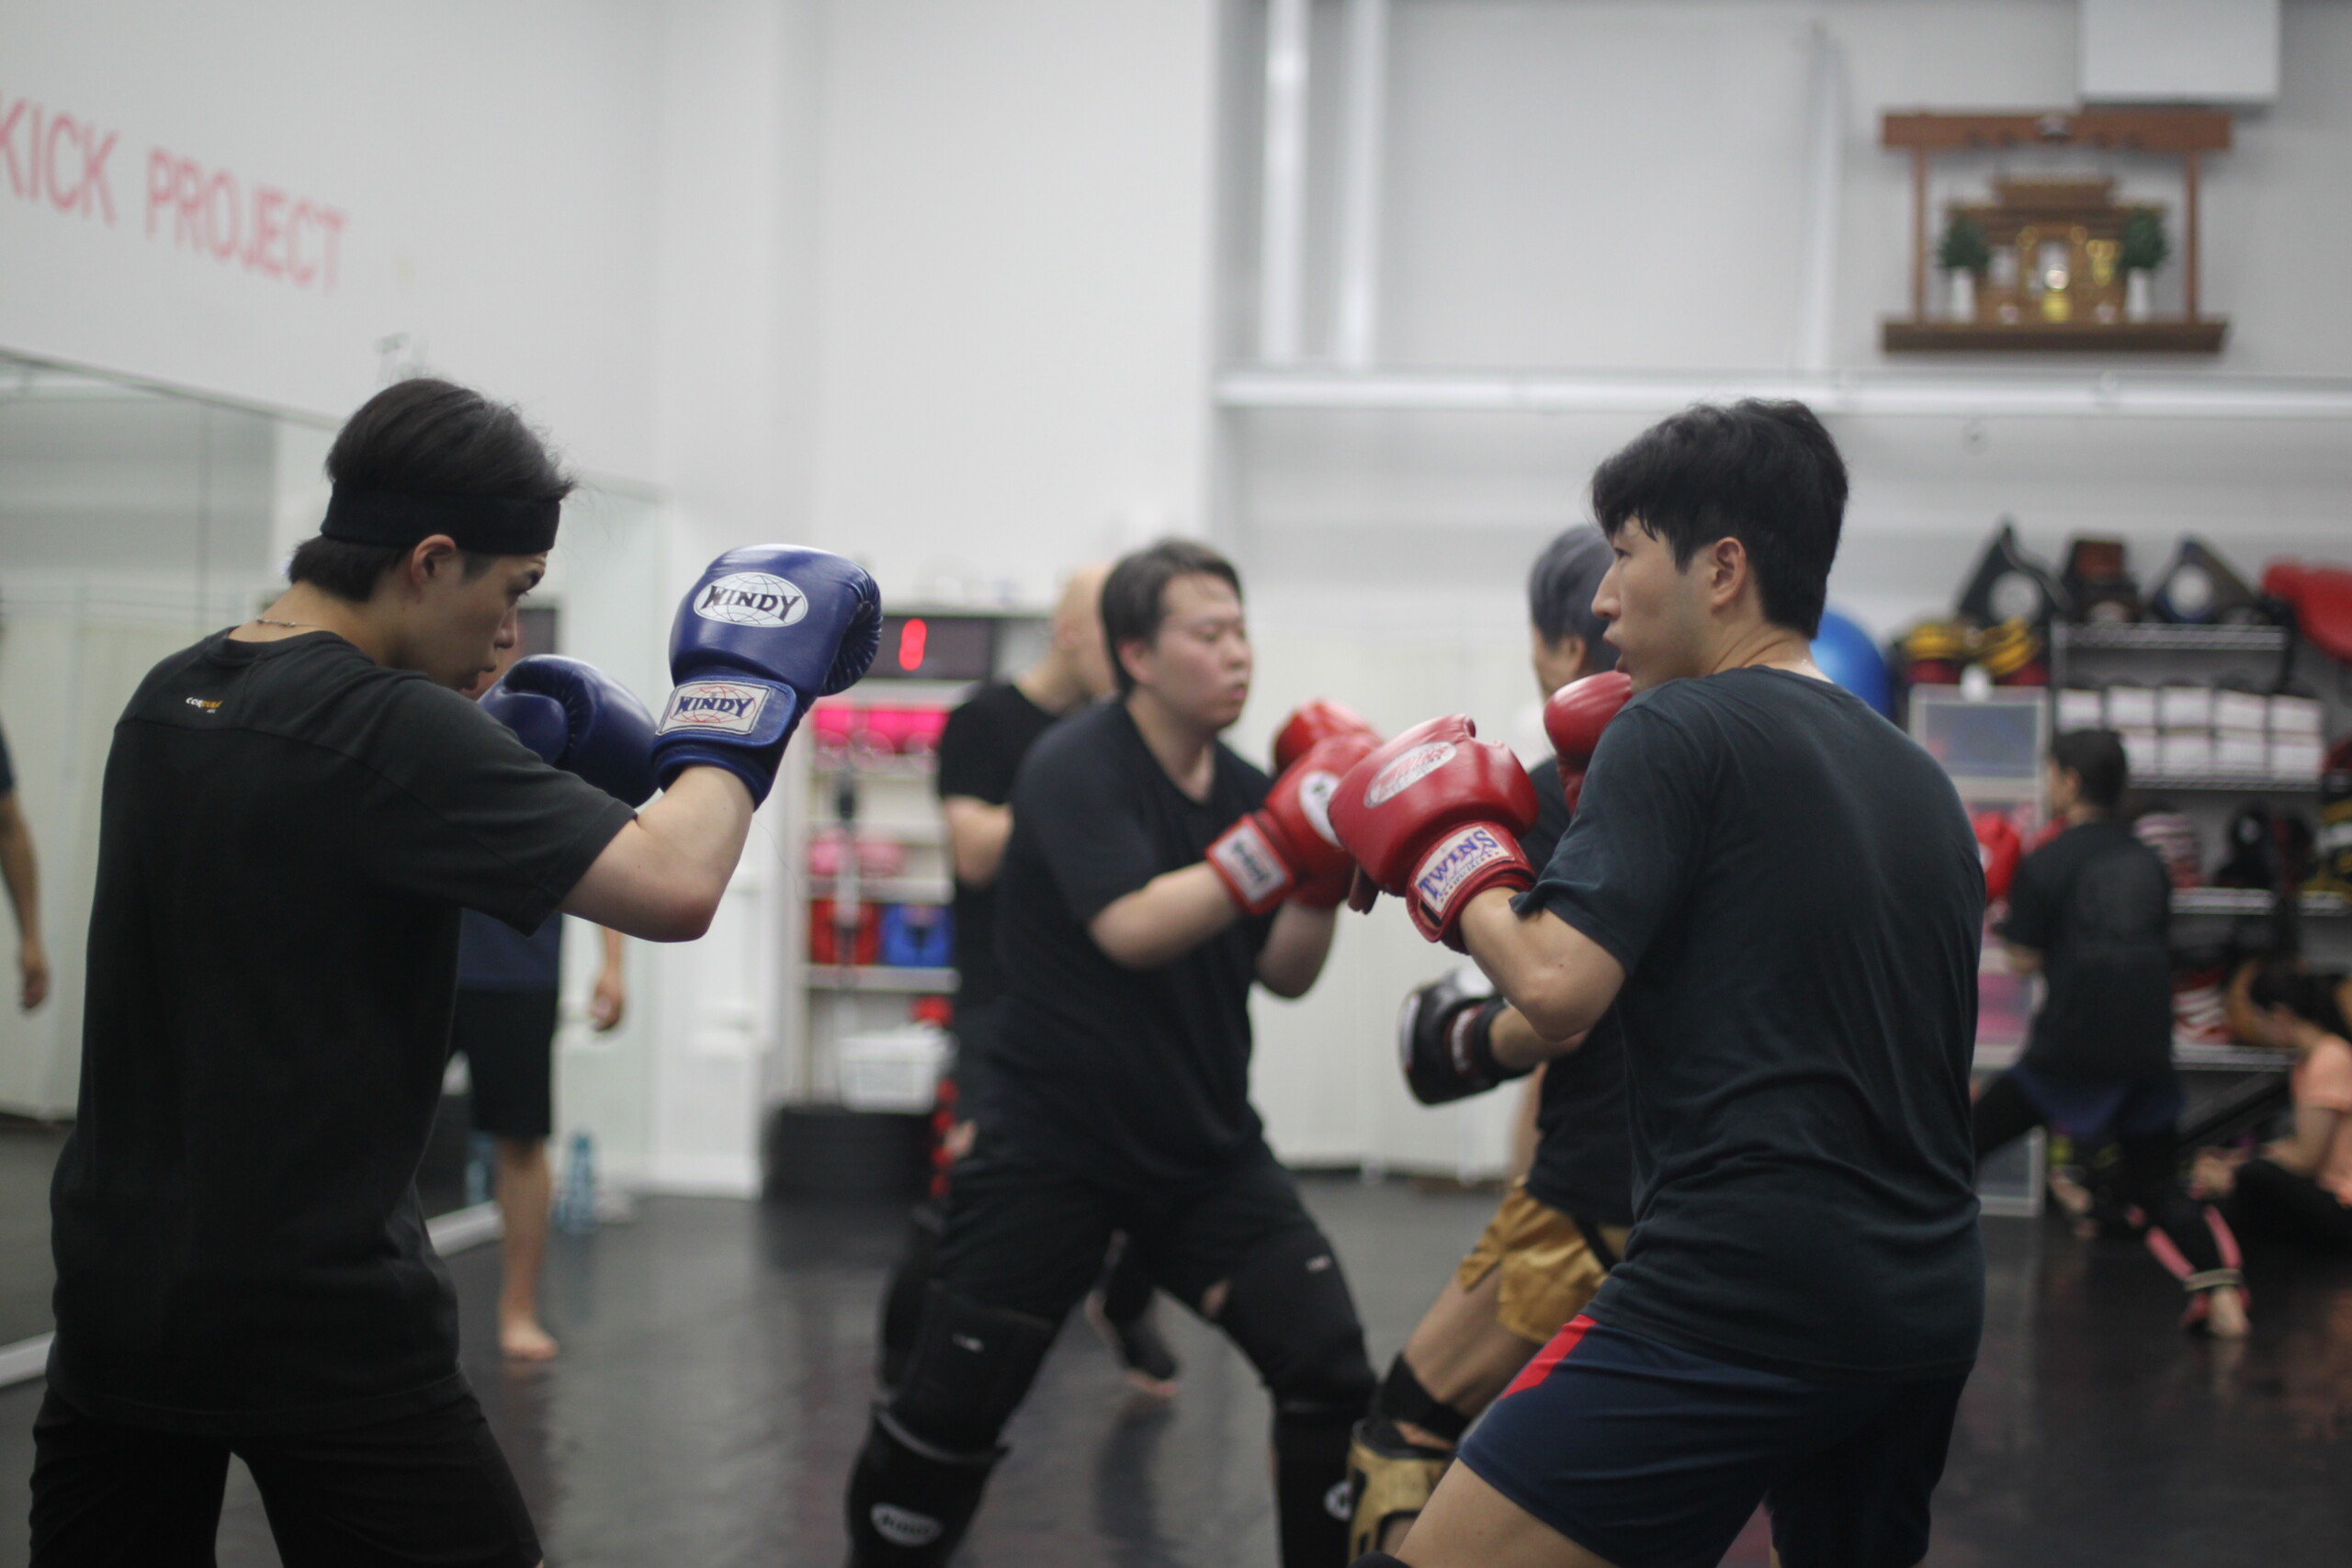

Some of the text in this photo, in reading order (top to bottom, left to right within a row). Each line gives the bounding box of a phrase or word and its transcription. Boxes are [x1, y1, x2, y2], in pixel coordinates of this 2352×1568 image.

[144, 145, 349, 298] PROJECT
[699, 584, 802, 625] WINDY
[673, 695, 755, 719] WINDY
[1418, 829, 1498, 900] TWINS
